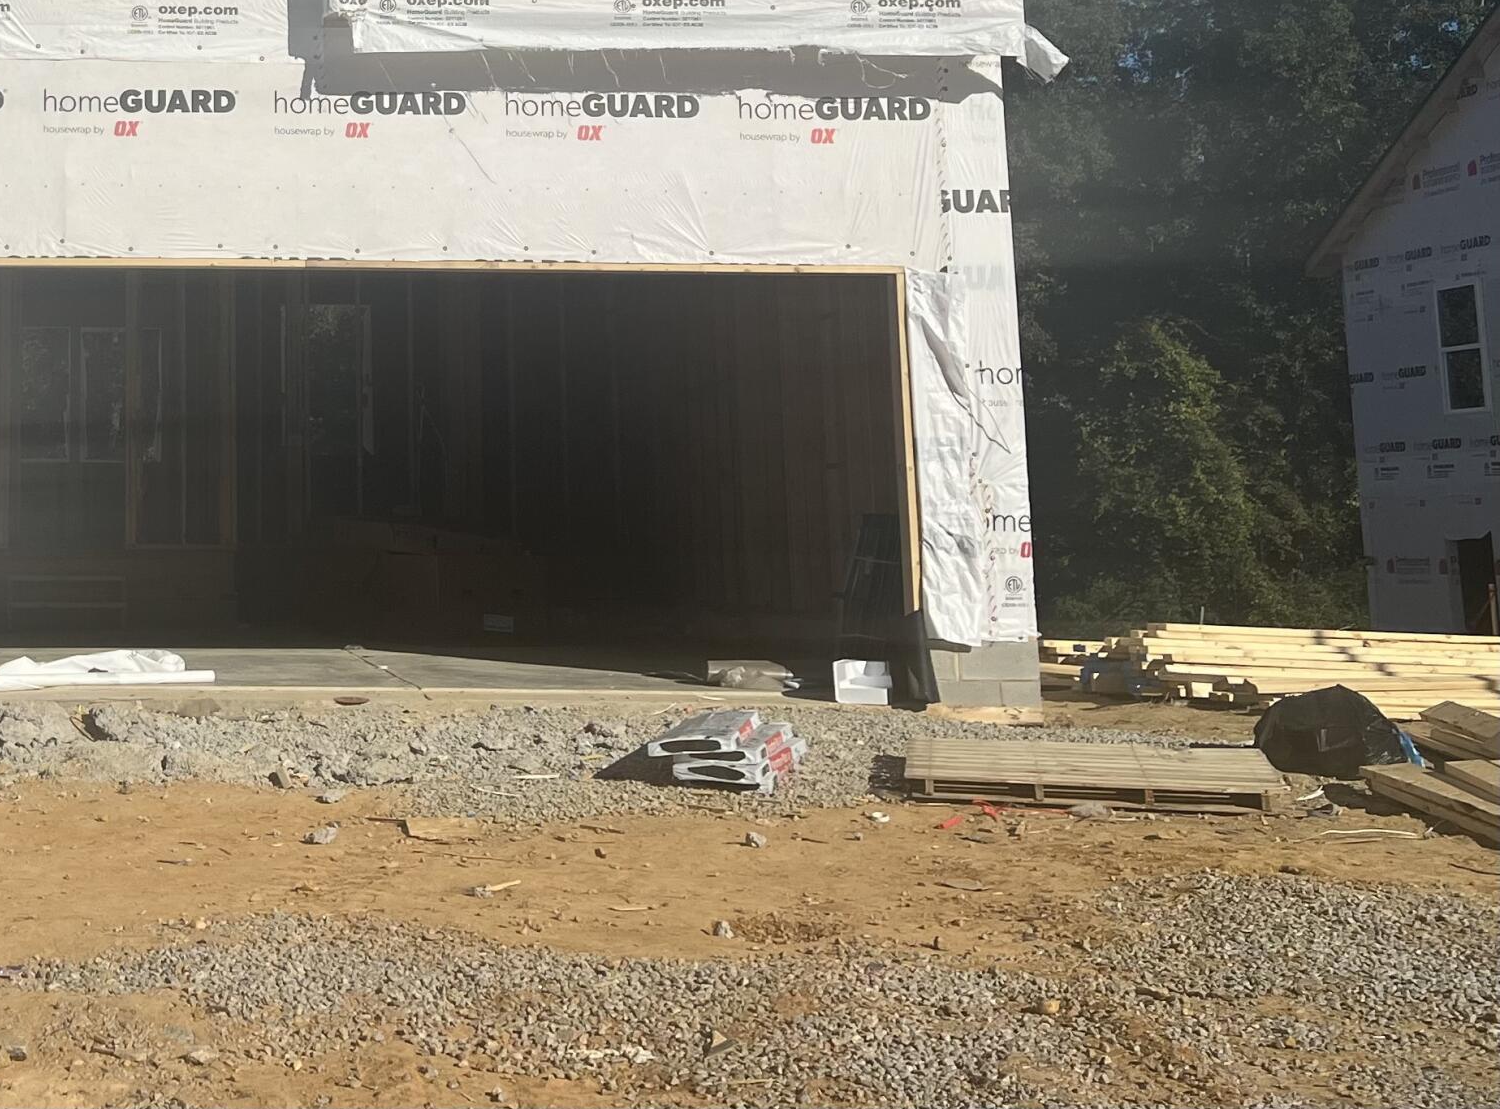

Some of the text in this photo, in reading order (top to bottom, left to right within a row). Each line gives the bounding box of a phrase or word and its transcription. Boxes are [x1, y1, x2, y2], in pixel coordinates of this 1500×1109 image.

[158, 6, 238, 18] oxep.com
[44, 88, 236, 113] homeGUARD
[274, 91, 466, 115] homeGUARD
[505, 92, 699, 118] homeGUARD
[739, 96, 931, 121] homeGUARD
[114, 121, 139, 137] OX
[345, 123, 371, 138] OX
[577, 125, 601, 141] OX
[810, 128, 835, 144] OX
